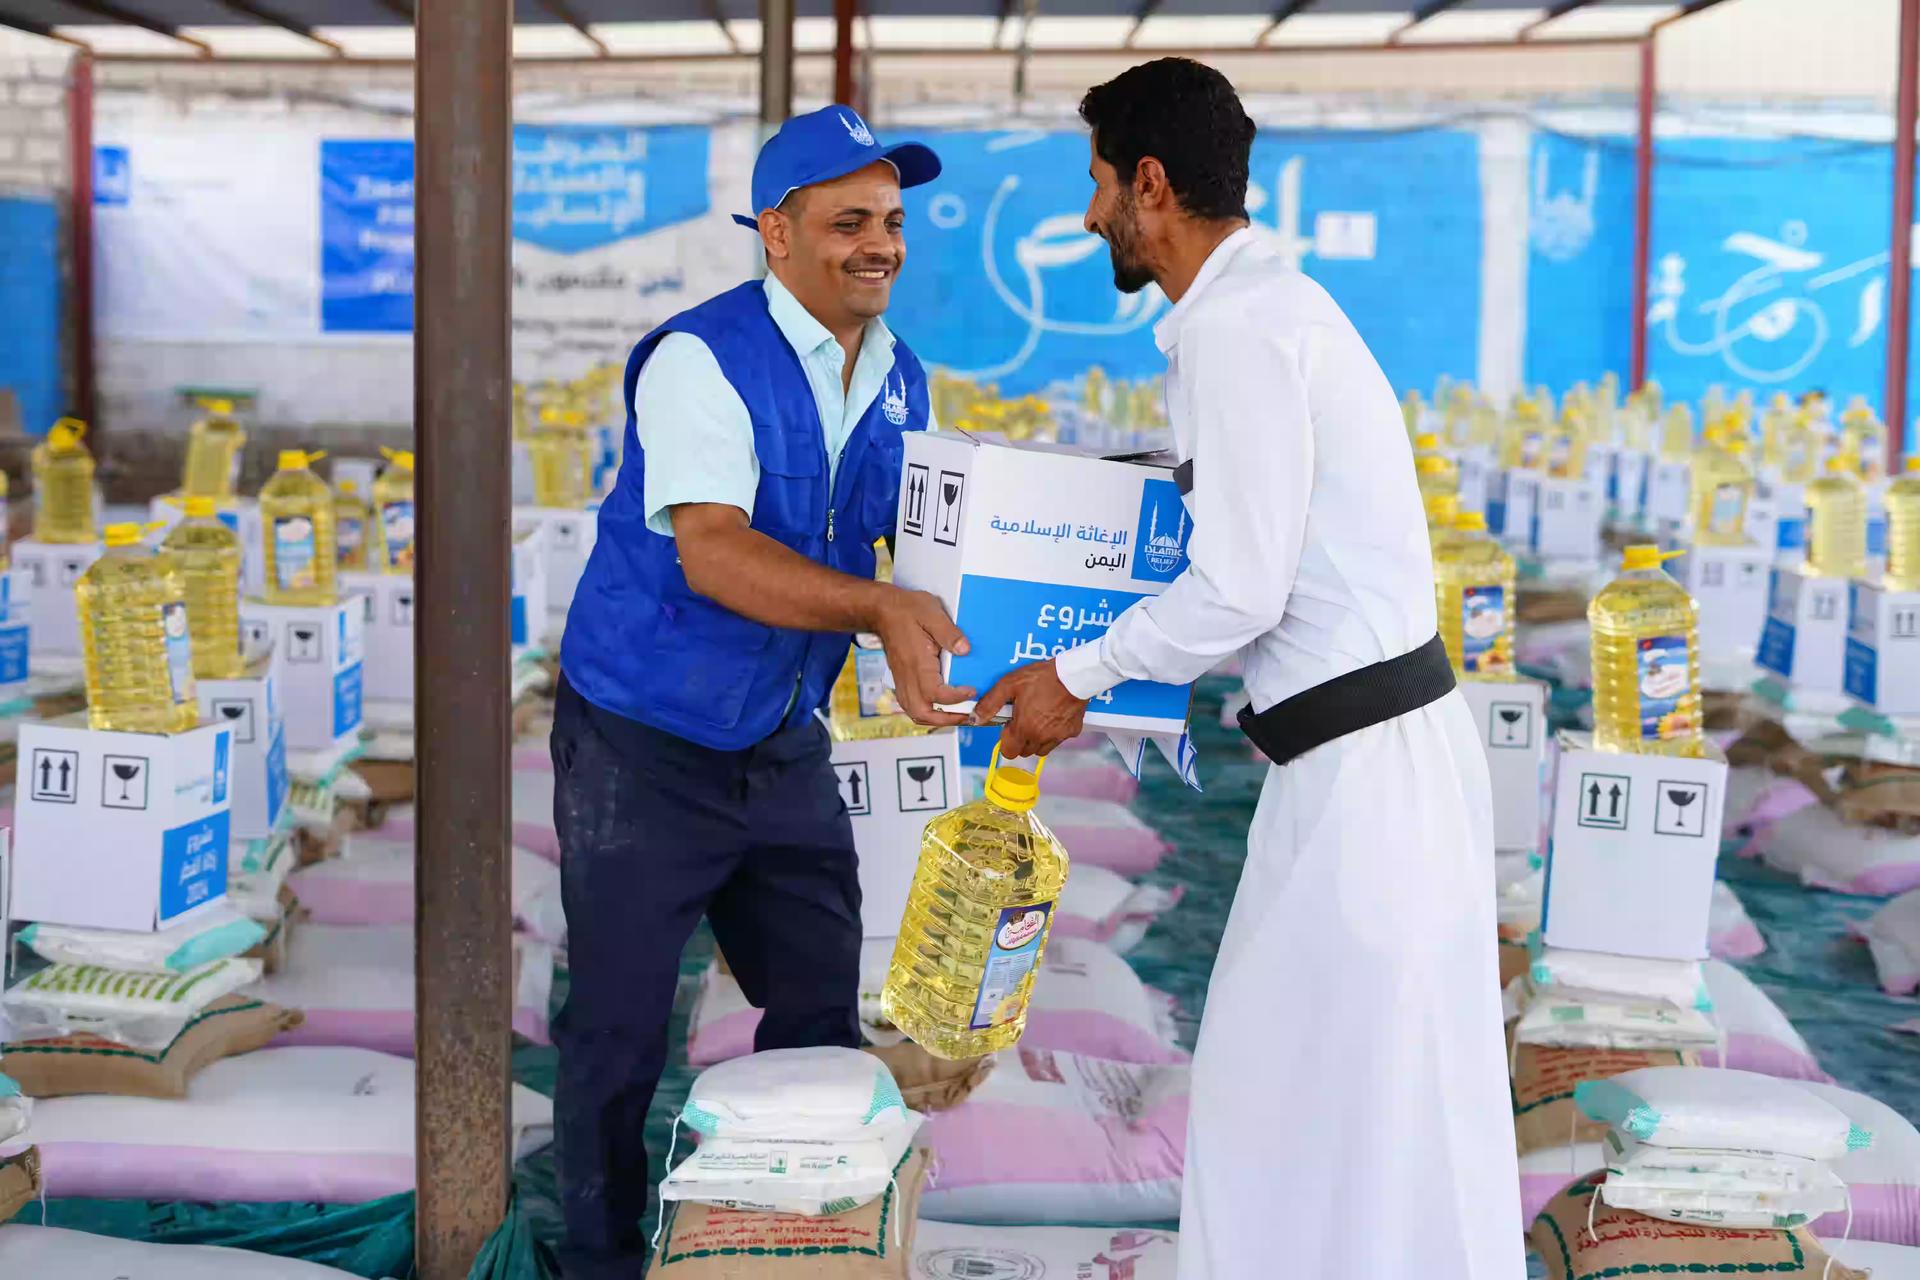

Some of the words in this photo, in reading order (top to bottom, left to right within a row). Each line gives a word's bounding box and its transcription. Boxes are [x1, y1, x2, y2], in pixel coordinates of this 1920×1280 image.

[990, 514, 1071, 543] الإسلامية
[1076, 524, 1127, 549] الإغاثة
[1144, 544, 1183, 557] ISLAMIC
[1150, 557, 1175, 565] RELIEF
[1085, 553, 1126, 571] اليمن
[1037, 598, 1113, 631] شروع
